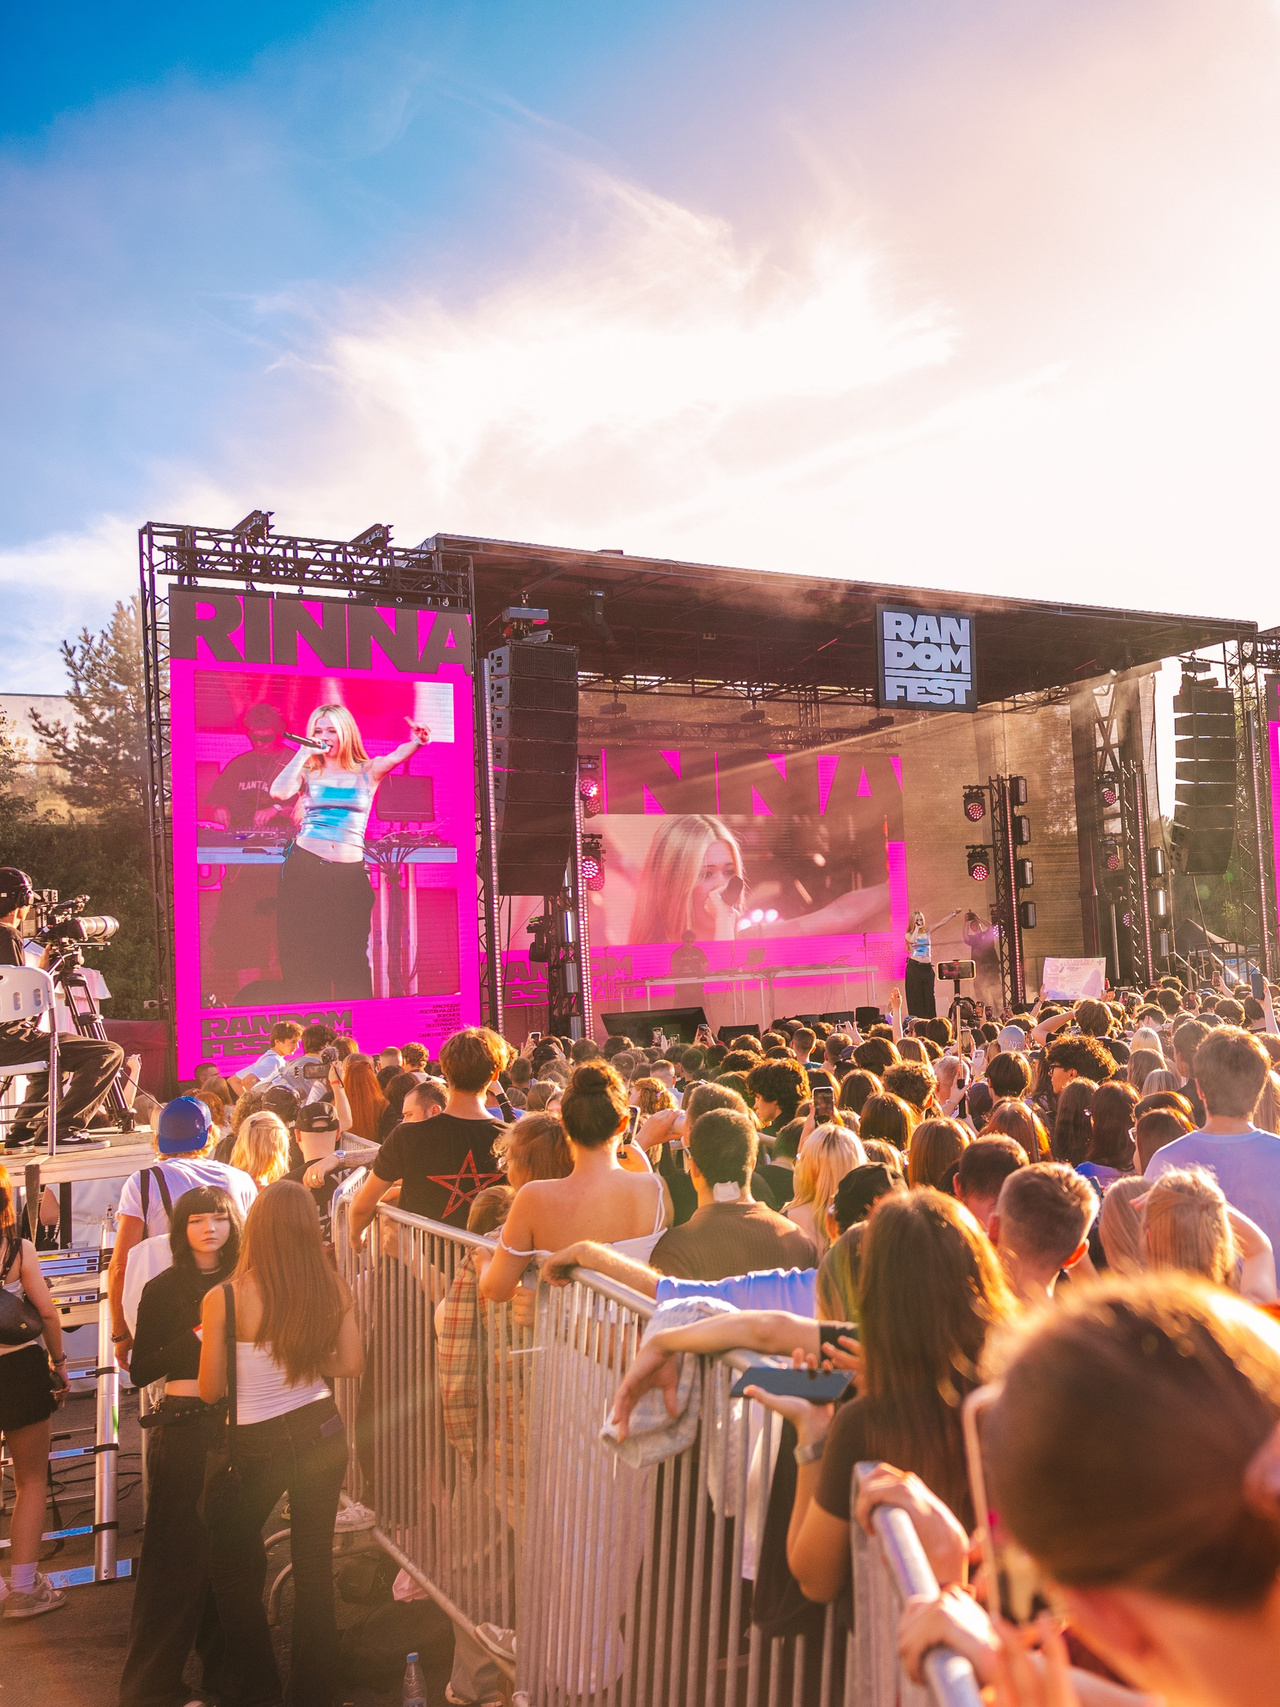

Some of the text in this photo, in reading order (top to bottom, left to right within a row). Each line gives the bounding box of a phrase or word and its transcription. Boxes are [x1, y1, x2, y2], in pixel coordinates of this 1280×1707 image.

[170, 588, 472, 676] RINNA
[883, 611, 970, 646] RAN
[884, 640, 971, 673] DOM
[885, 676, 972, 705] FEST
